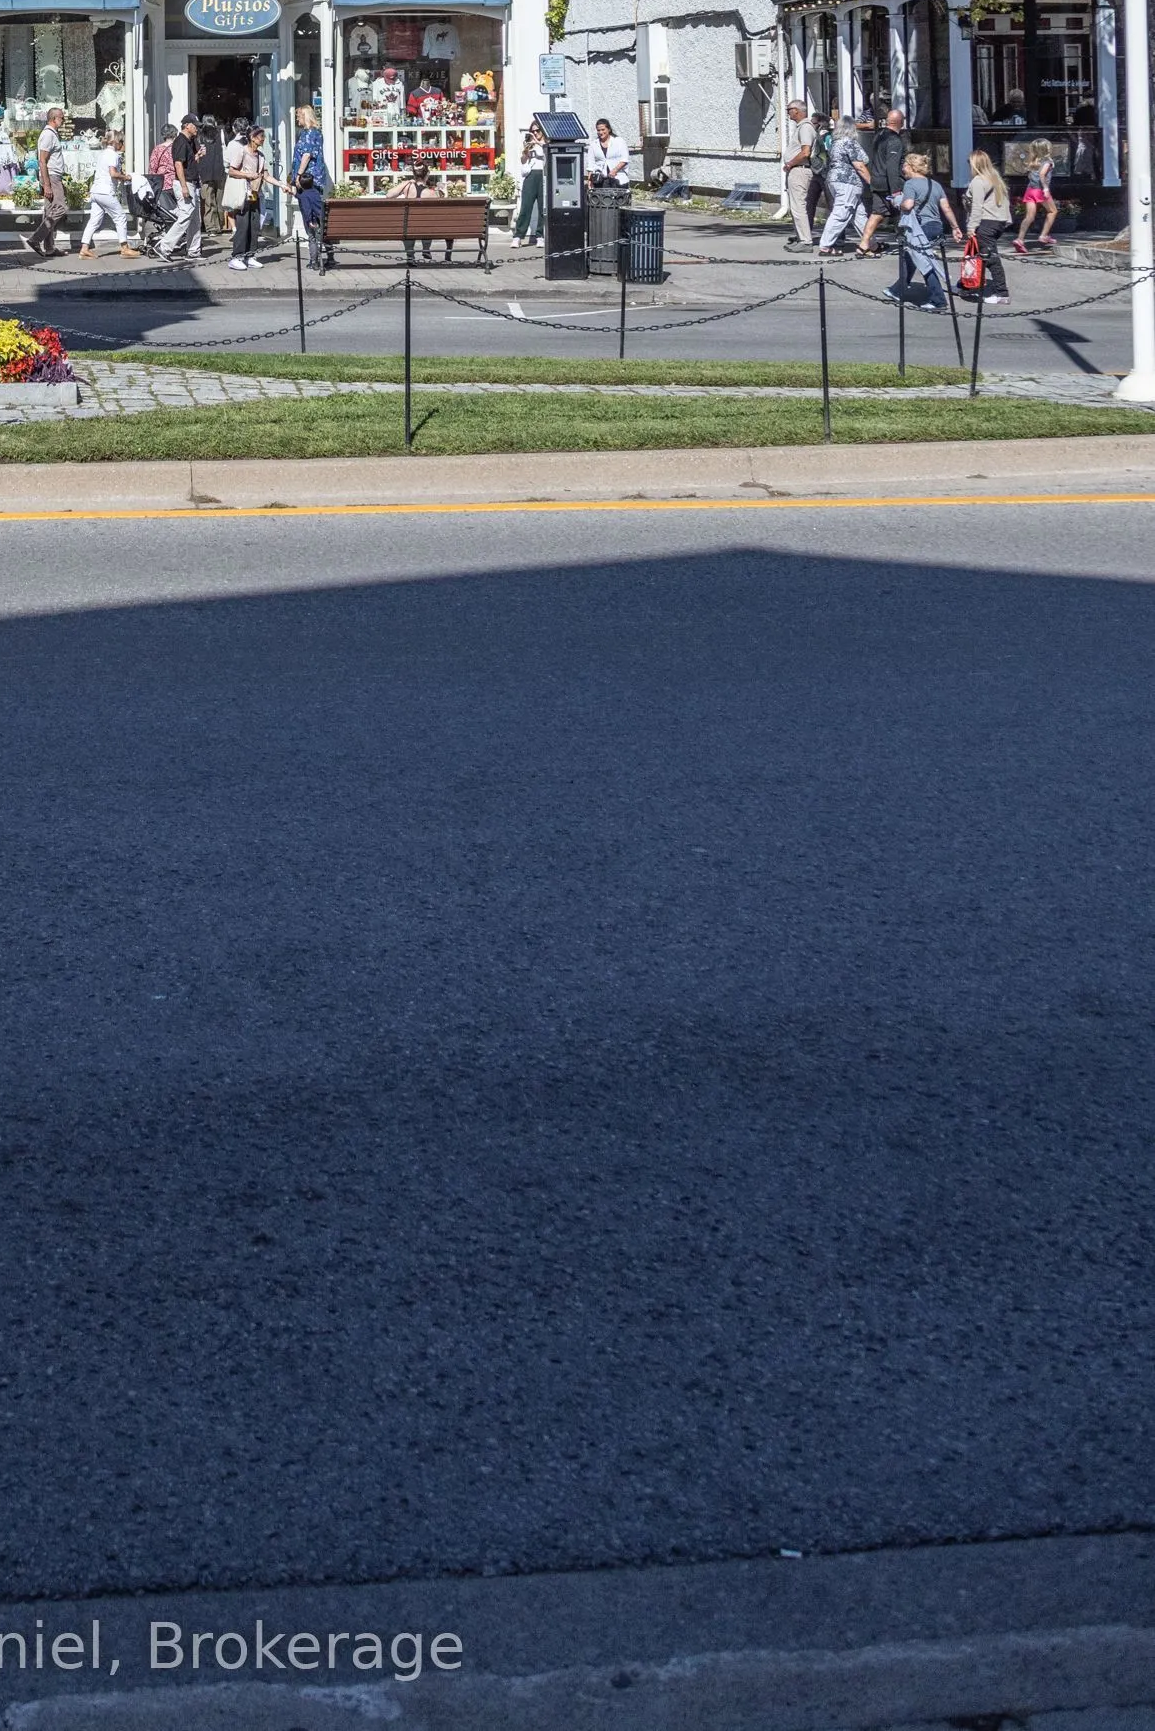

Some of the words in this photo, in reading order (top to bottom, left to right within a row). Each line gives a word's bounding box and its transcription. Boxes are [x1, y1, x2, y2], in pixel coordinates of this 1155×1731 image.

[214, 13, 254, 30] Gifts
[408, 71, 446, 79] KEZIE
[371, 150, 399, 161] Gifts
[411, 149, 467, 159] Souvenirs
